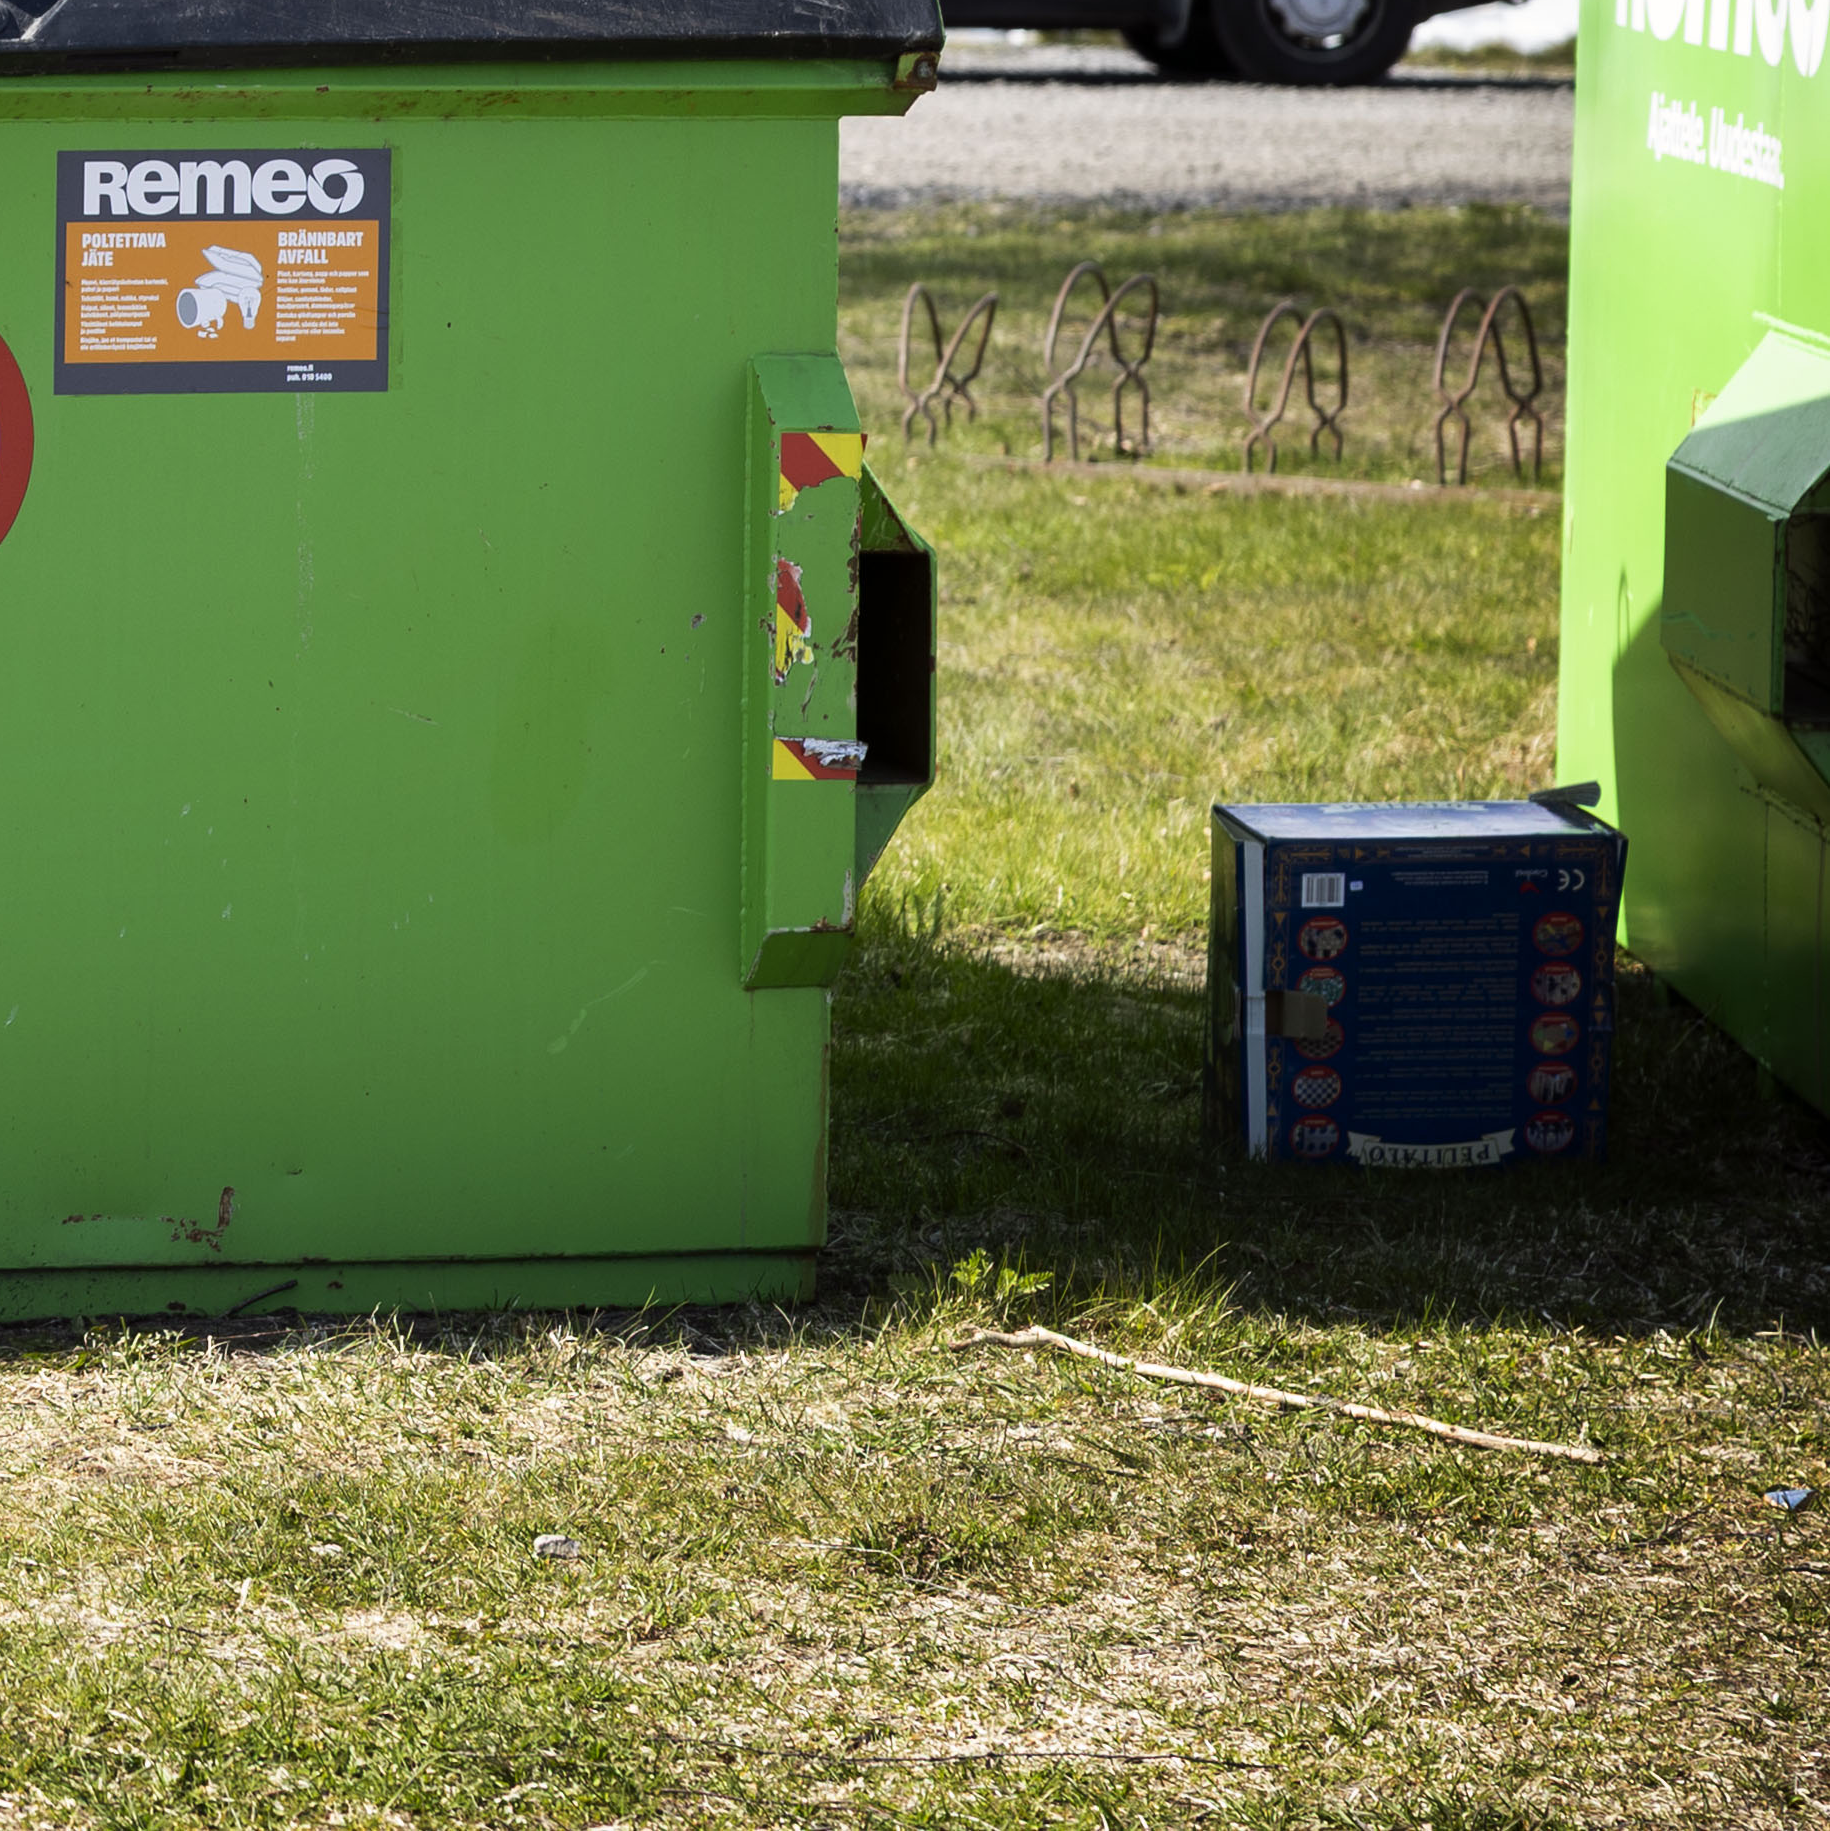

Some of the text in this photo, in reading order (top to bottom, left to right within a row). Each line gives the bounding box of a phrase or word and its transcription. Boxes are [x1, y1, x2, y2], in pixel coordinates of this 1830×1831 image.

[83, 158, 365, 216] Remeo
[81, 232, 167, 248] POLTETTAVA
[277, 229, 364, 248] BRÄNNBART
[81, 250, 114, 267] JÄTE
[277, 249, 329, 265] AVFALL
